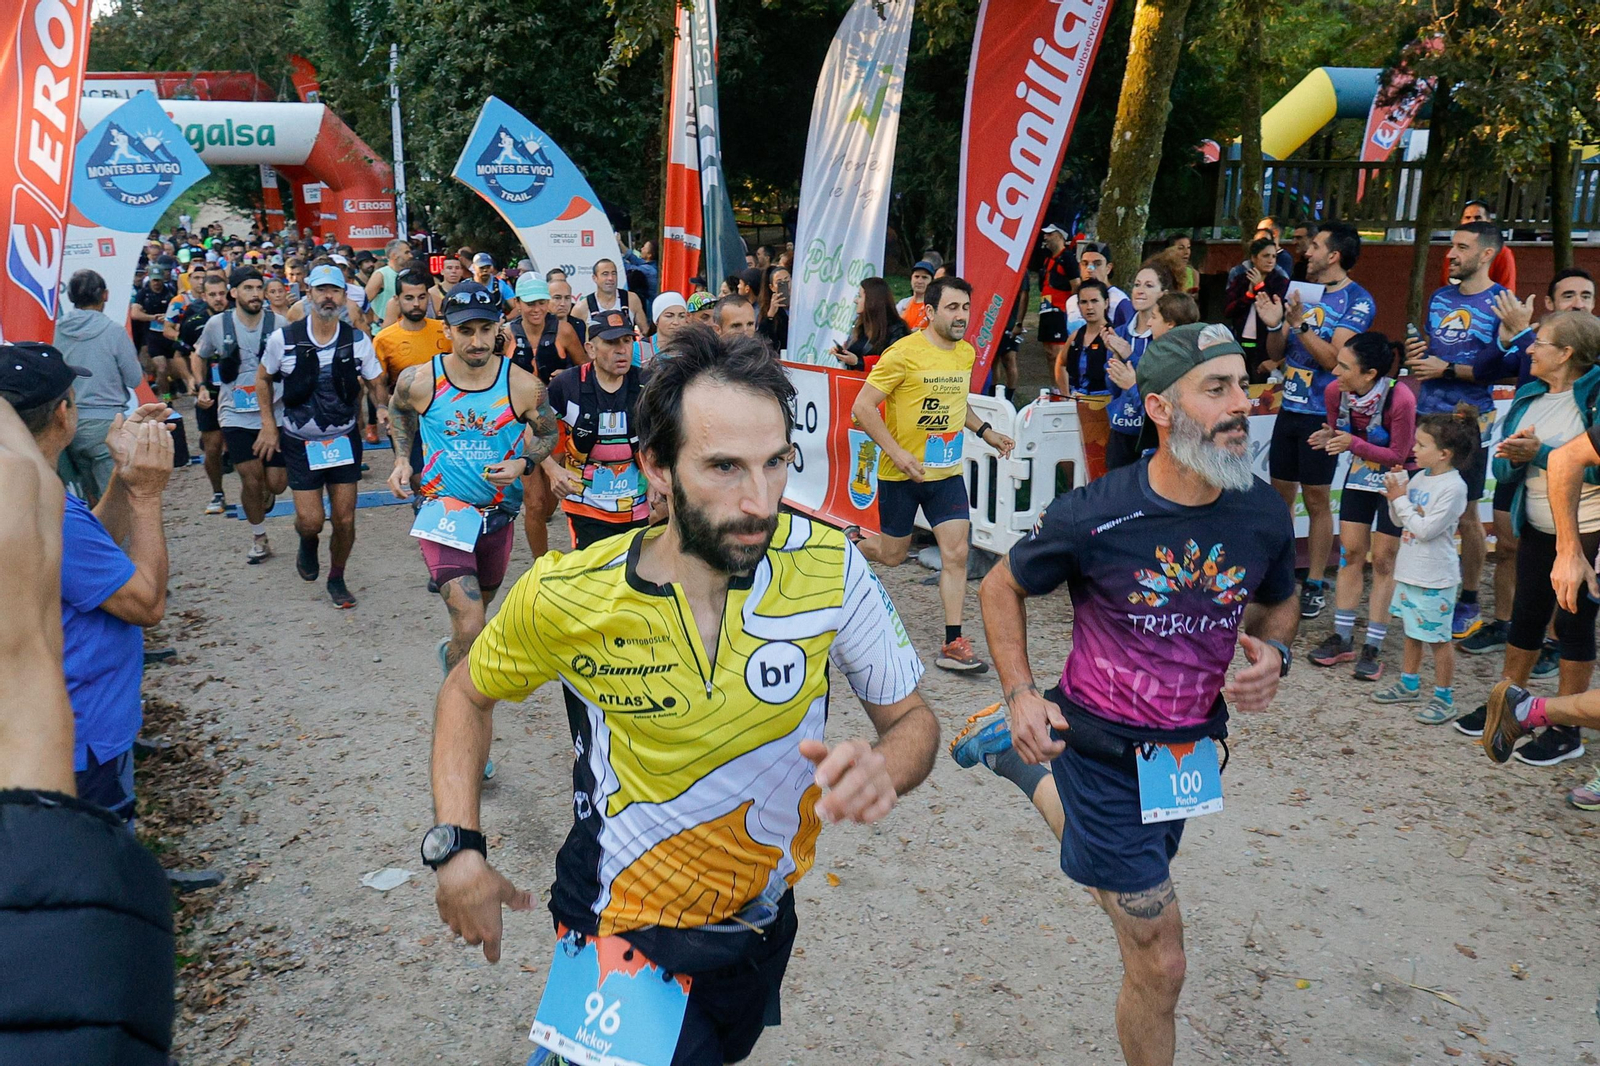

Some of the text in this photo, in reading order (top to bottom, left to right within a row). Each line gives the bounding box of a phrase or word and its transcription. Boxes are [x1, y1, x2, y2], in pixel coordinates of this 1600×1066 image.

[1076, 4, 1105, 77] autoservicios
[29, 0, 77, 185] ERO
[172, 117, 276, 154] galsa
[88, 161, 181, 178] MONTES DE VIGO
[477, 164, 553, 176] MONTES DE VIGO
[120, 191, 158, 205] TRAIL
[500, 189, 532, 202] TRAIL
[358, 201, 392, 211] EROSKI
[921, 397, 940, 410] RG
[1112, 413, 1144, 427] Lend
[453, 439, 491, 451] TRAIL
[322, 448, 341, 460] 162
[943, 447, 954, 459] 15
[609, 479, 628, 490] 140
[437, 517, 456, 533] 86
[626, 635, 671, 646] OTTOBOSLEY
[598, 663, 679, 679] Sumipor
[759, 659, 796, 689] br
[599, 693, 643, 706] ATLAS
[1169, 769, 1203, 797] 100
[1175, 794, 1198, 806] Pincho
[584, 991, 621, 1036] 96
[575, 1025, 613, 1056] Mckay
